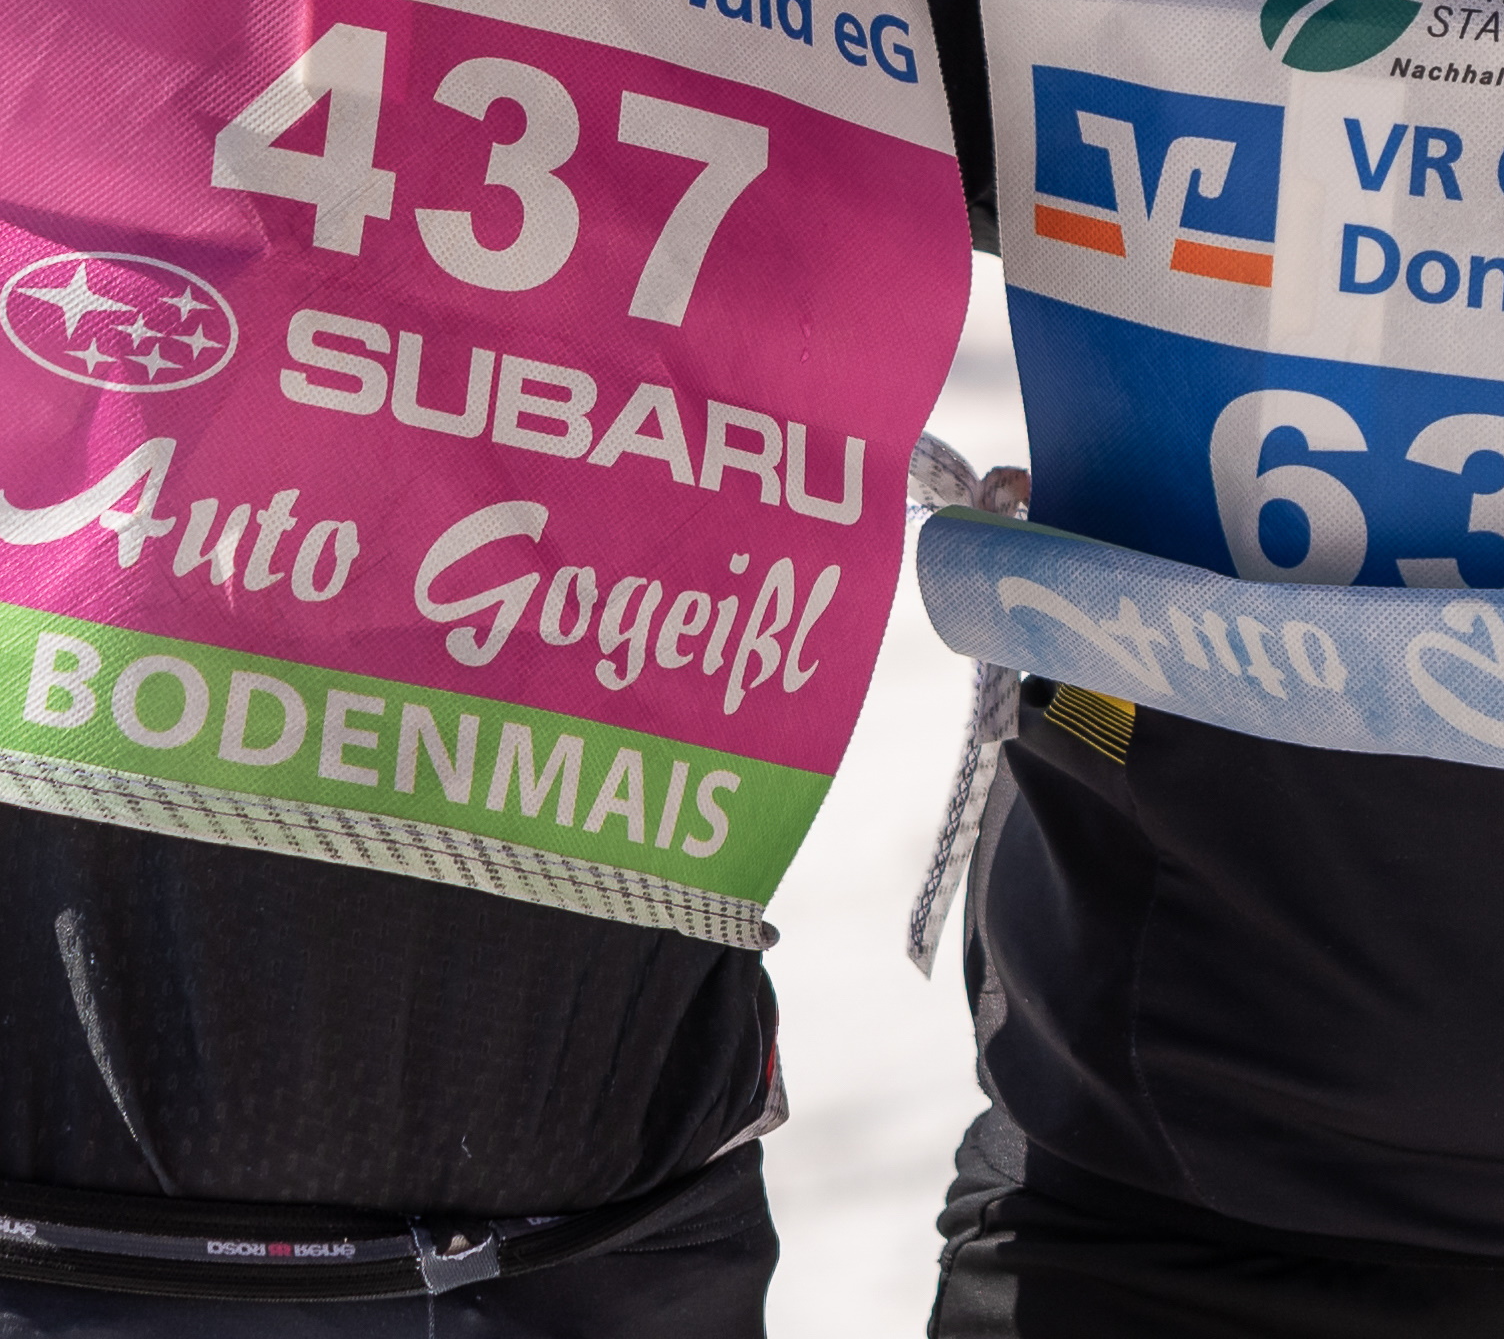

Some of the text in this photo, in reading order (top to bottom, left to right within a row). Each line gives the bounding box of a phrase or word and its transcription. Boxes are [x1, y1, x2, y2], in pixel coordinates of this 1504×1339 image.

[833, 11, 919, 84] eG
[208, 19, 772, 329] 437
[1344, 117, 1466, 201] VR
[278, 308, 867, 529] SUBARU
[411, 498, 843, 716] Gogeißl
[19, 628, 743, 862] BODENMAIS
